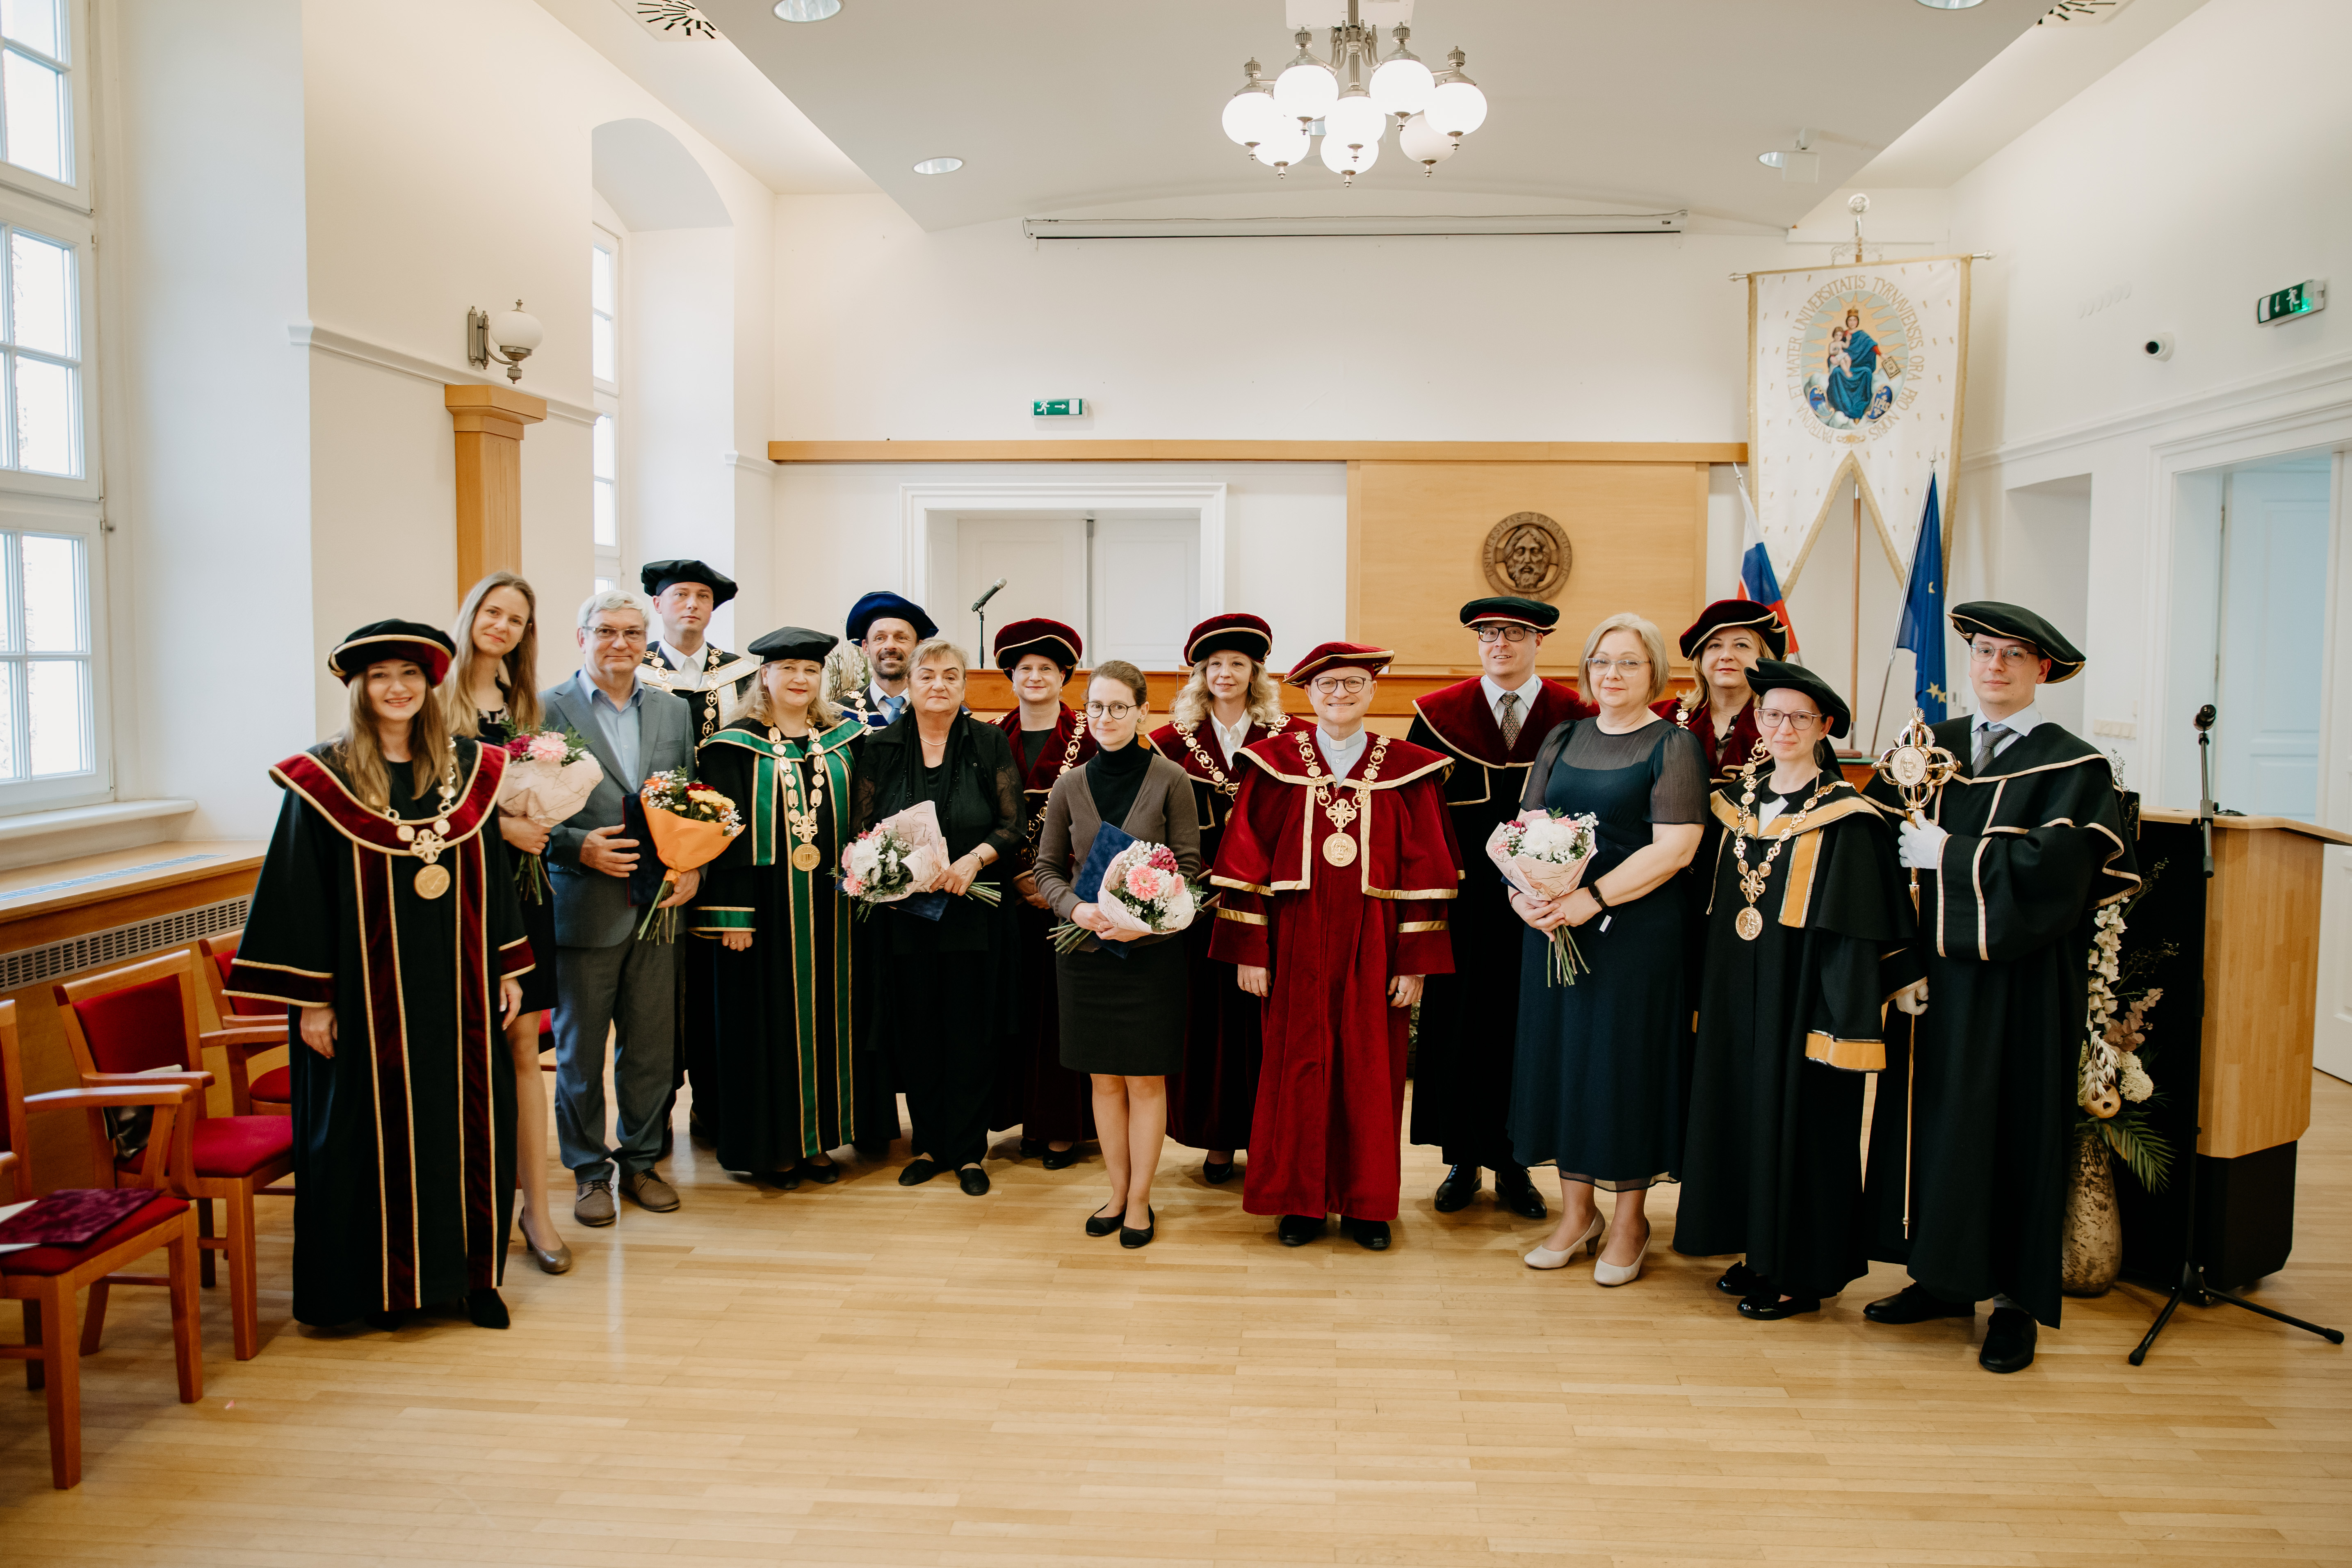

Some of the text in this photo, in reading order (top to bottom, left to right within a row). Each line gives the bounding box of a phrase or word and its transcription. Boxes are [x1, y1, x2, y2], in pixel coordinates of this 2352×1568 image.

[1786, 275, 1925, 444] PATRONA ET MATER UNIVERSITATIS TYRNAVIENSIS ORA PRO NOBIS
[1483, 514, 1521, 577] UNIVERSITAS
